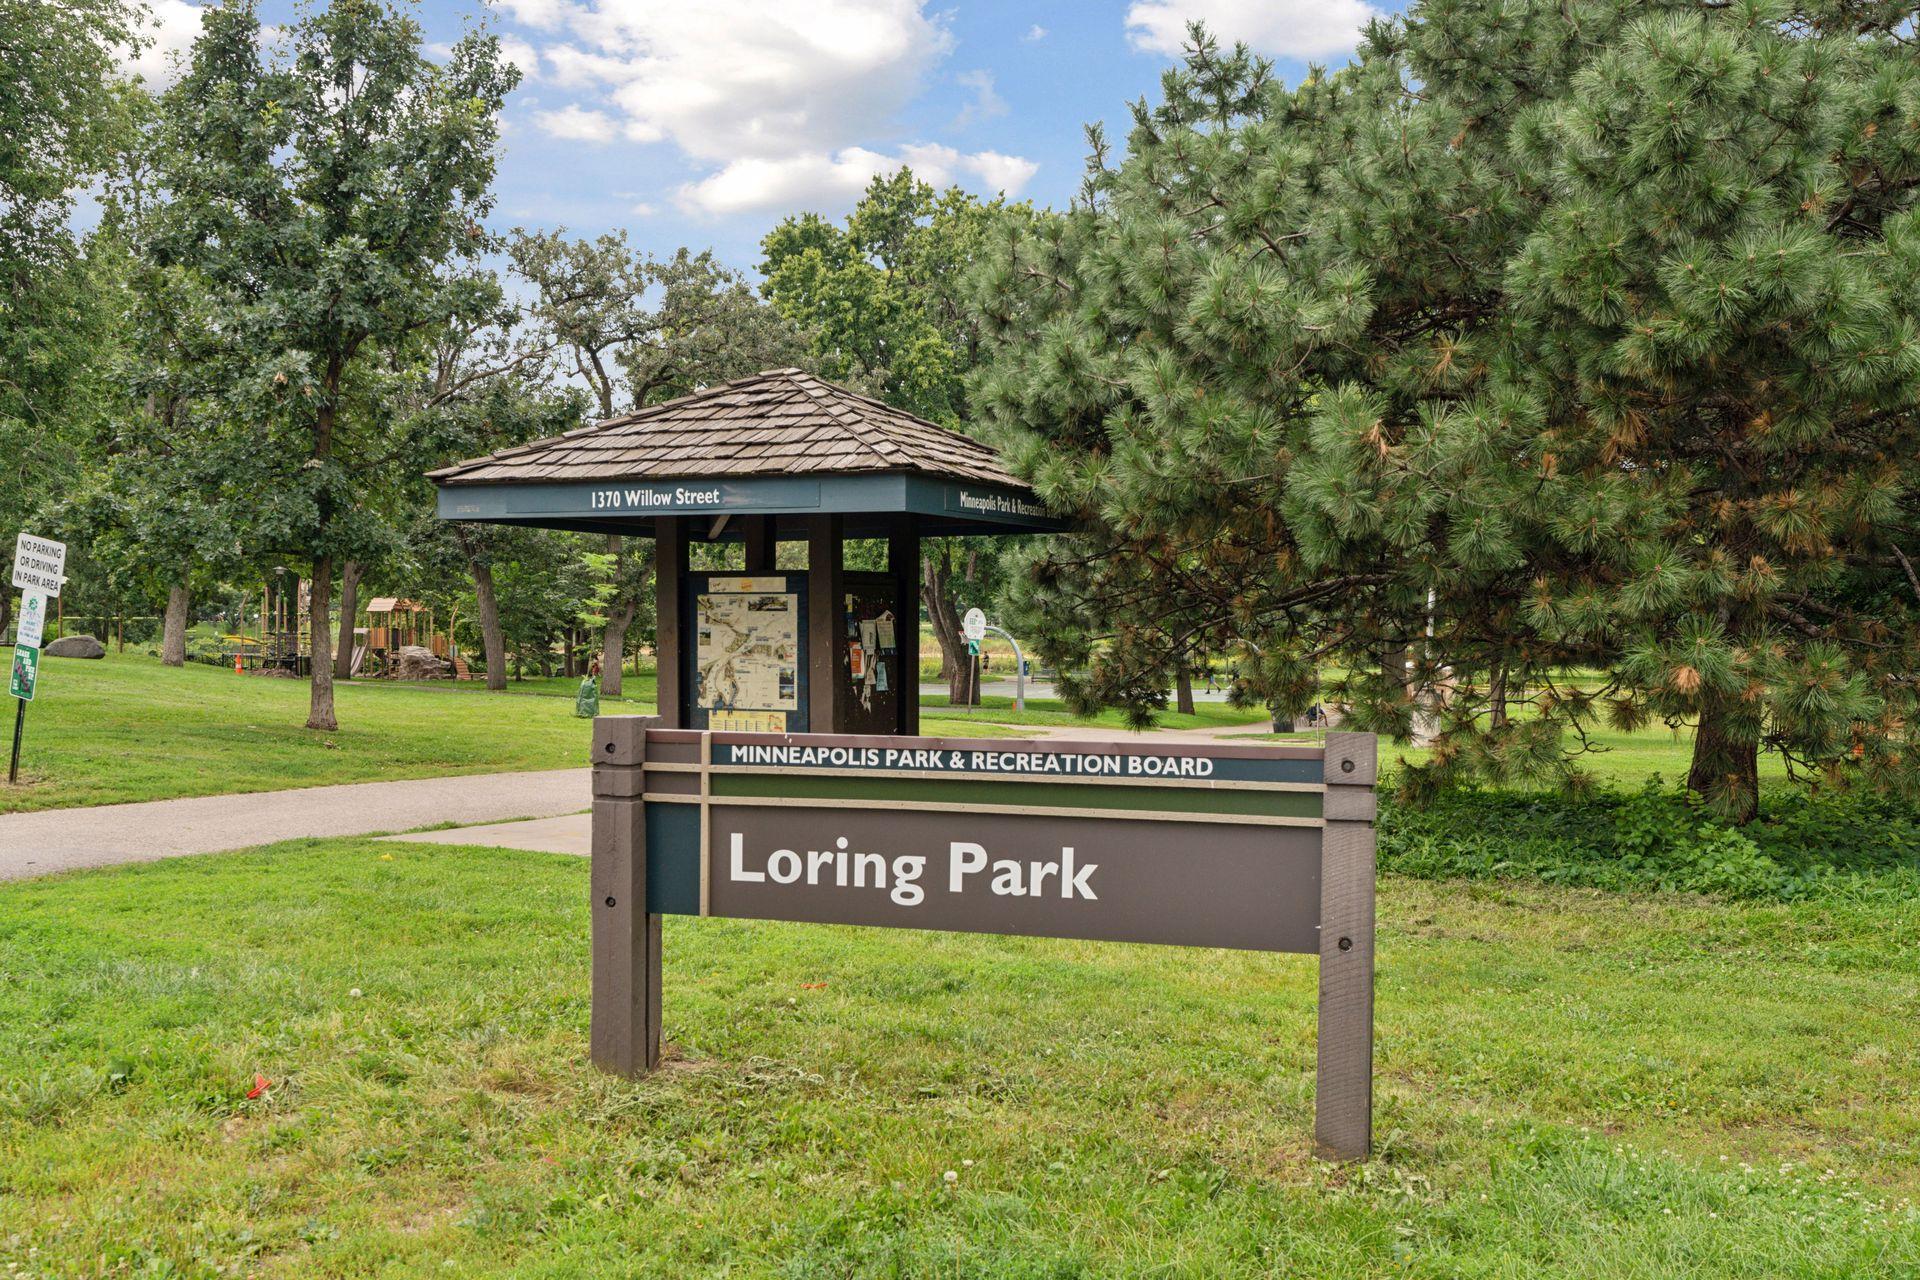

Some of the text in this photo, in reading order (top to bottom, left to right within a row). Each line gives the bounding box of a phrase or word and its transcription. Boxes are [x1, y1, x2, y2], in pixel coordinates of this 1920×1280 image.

[592, 488, 720, 508] 1370 Willow Street
[960, 491, 997, 514] Minneapolis
[997, 496, 1011, 513] Park
[1011, 498, 1017, 513] &
[20, 540, 61, 559] NO PARKING
[20, 556, 58, 575] OR DRIVING
[14, 570, 58, 591] IN PARK AREA
[731, 745, 1213, 776] MINNEAPOLIS PARK & RECREATION BOARD
[730, 832, 1098, 906] Loring Park
